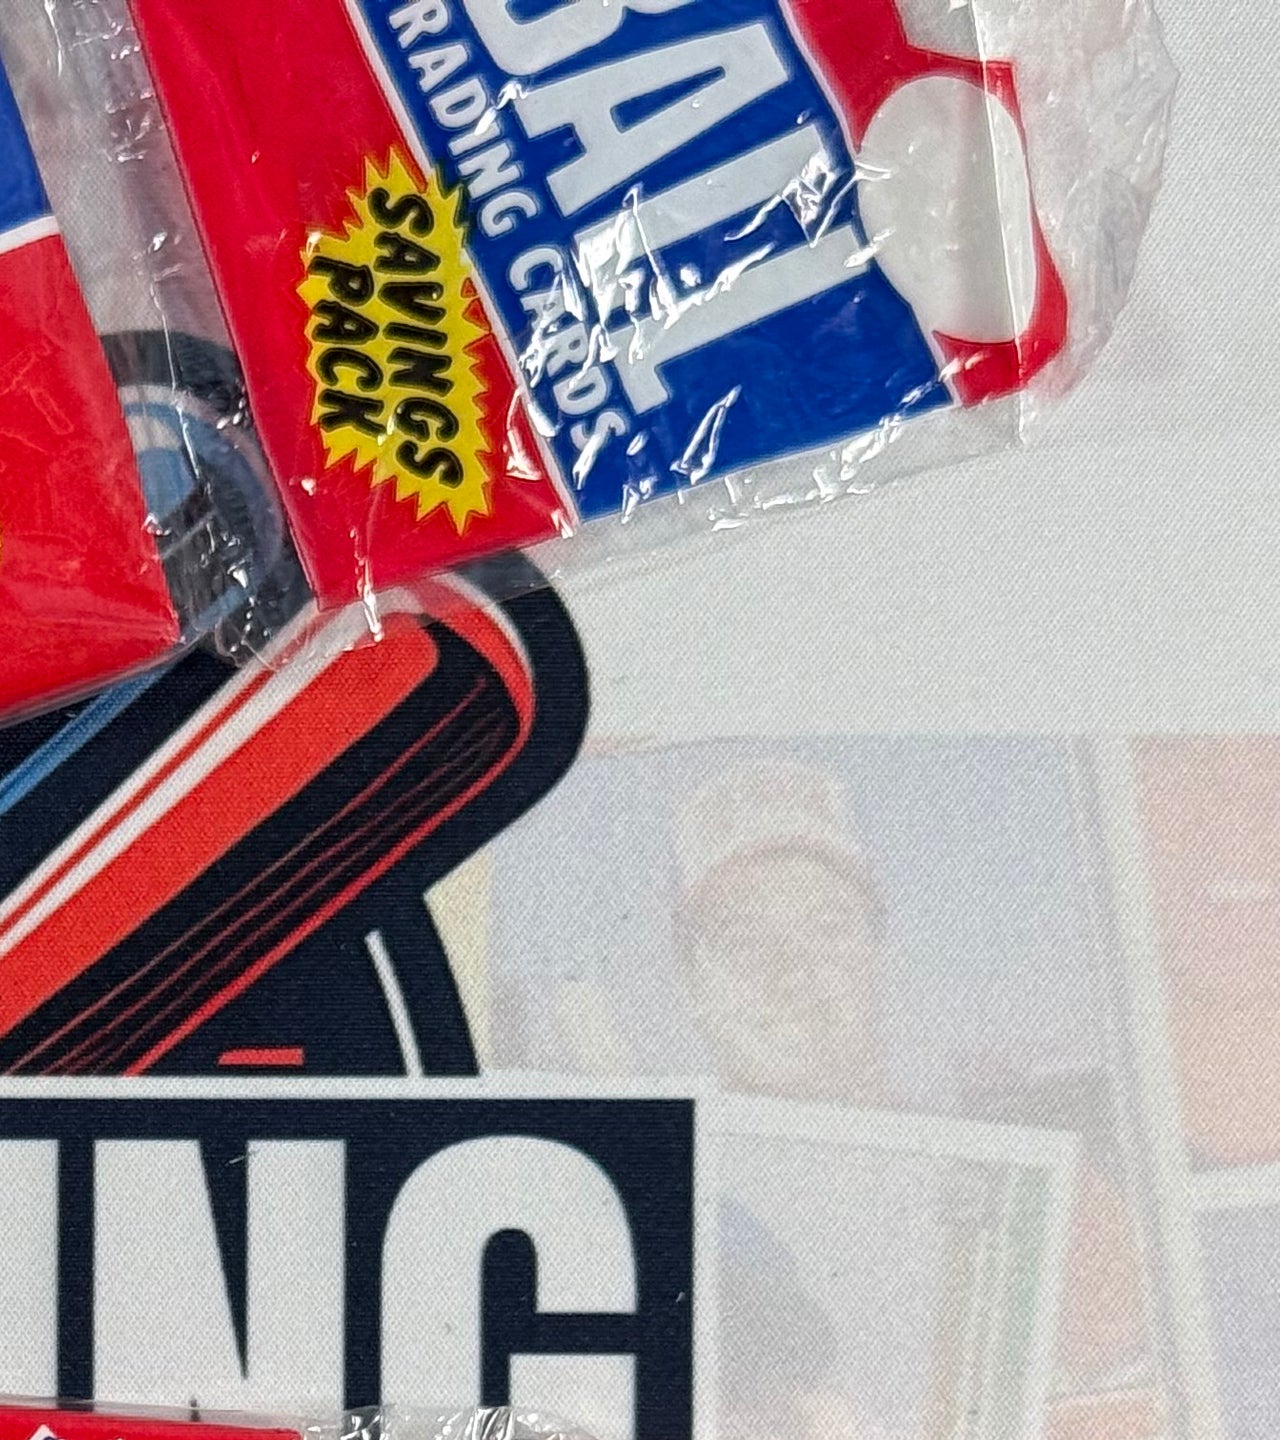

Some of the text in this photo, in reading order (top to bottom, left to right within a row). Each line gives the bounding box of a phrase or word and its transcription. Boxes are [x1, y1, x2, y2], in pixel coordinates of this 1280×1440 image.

[312, 254, 385, 436] PACK
[366, 187, 464, 488] SAVINGS
[389, 0, 626, 465] RADING CARDS
